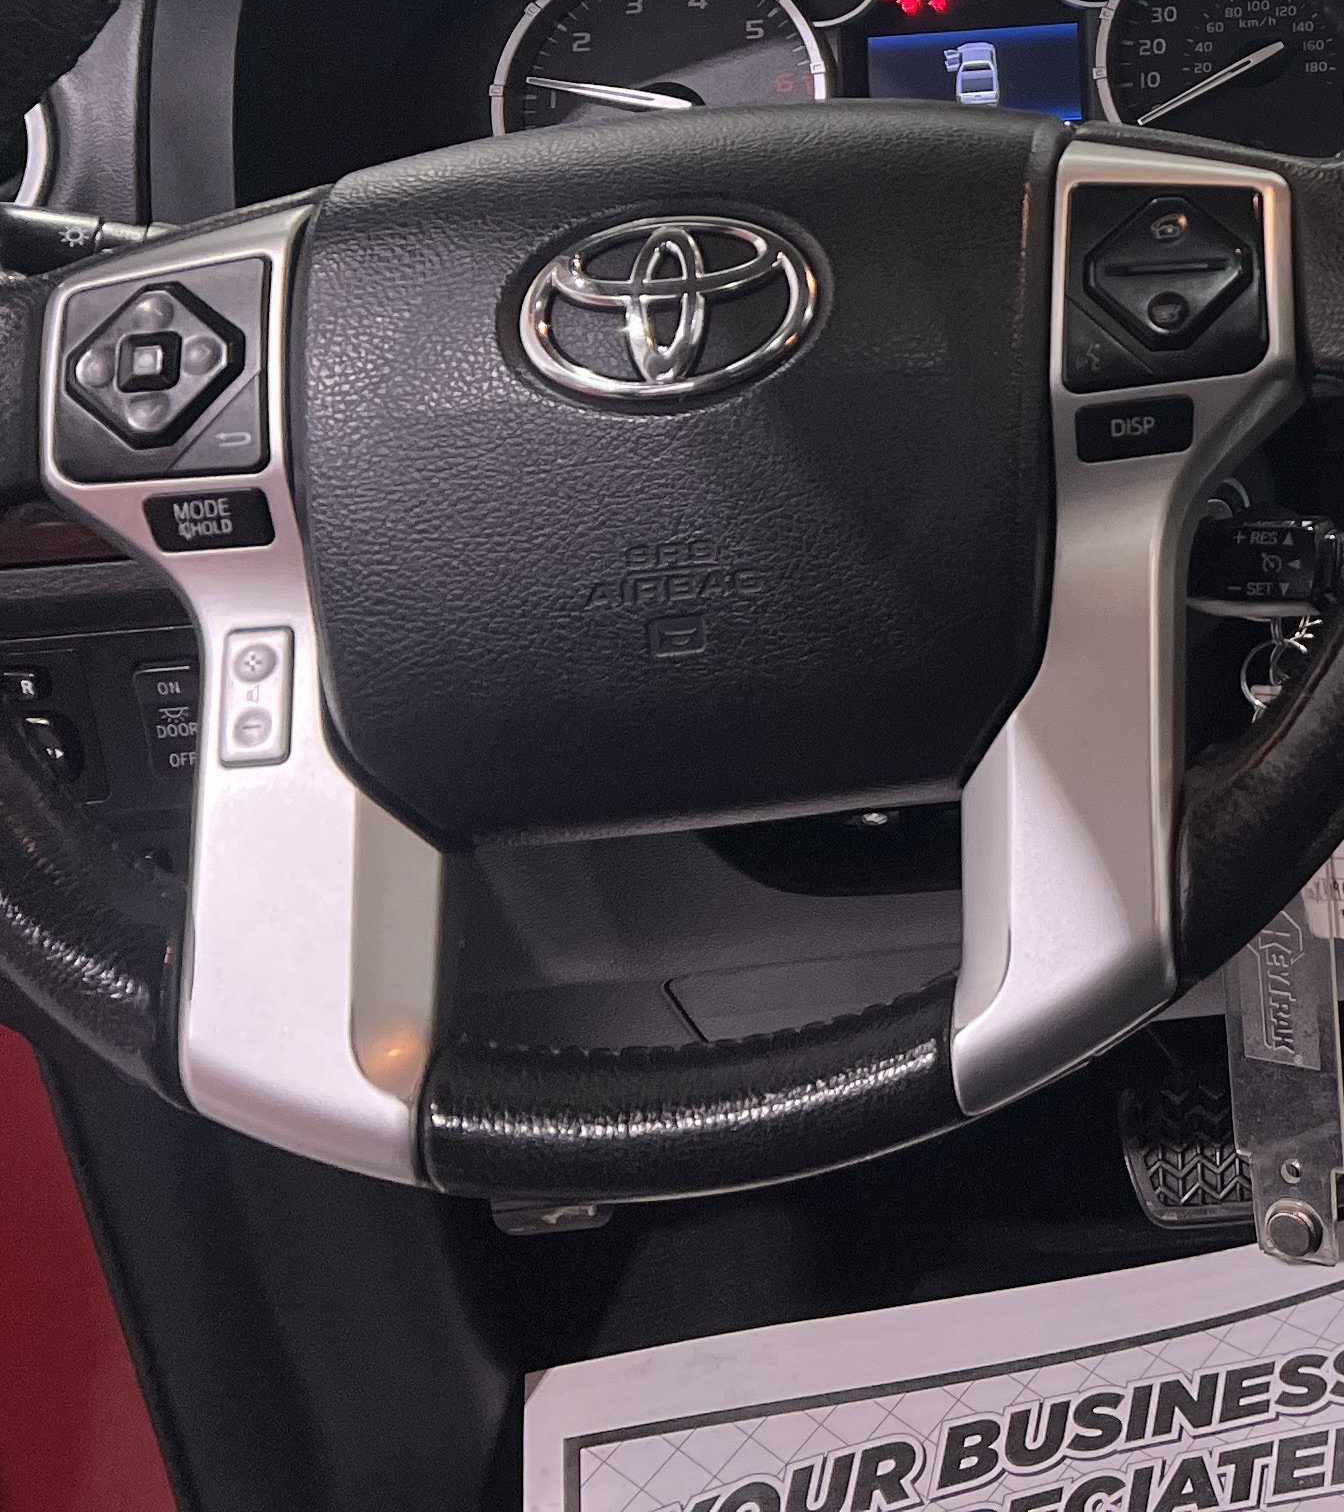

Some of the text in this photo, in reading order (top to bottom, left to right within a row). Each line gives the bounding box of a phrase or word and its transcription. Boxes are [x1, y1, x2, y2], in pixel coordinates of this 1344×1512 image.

[1225, 6, 1242, 18] 80
[1247, 0, 1270, 12] 100
[1275, 5, 1297, 17] 120
[1151, 6, 1177, 23] 30
[1239, 16, 1276, 28] km/h
[745, 19, 764, 39] 5
[1206, 21, 1224, 33] 60
[1292, 20, 1314, 33] 140
[572, 32, 591, 52] 2
[1138, 38, 1166, 55] 20
[1194, 41, 1213, 53] 40
[1302, 39, 1325, 51] 160
[1193, 61, 1212, 74] 20
[1305, 61, 1328, 73] 180
[1140, 71, 1161, 89] 10
[1110, 416, 1155, 438] DISP
[173, 497, 231, 521] MODE
[192, 519, 233, 535] HOLD
[1250, 531, 1278, 546] RES
[1246, 582, 1274, 597] SET
[20, 679, 35, 696] R
[157, 680, 181, 695] ON
[156, 721, 199, 739] DOOR
[169, 751, 197, 768] OFF
